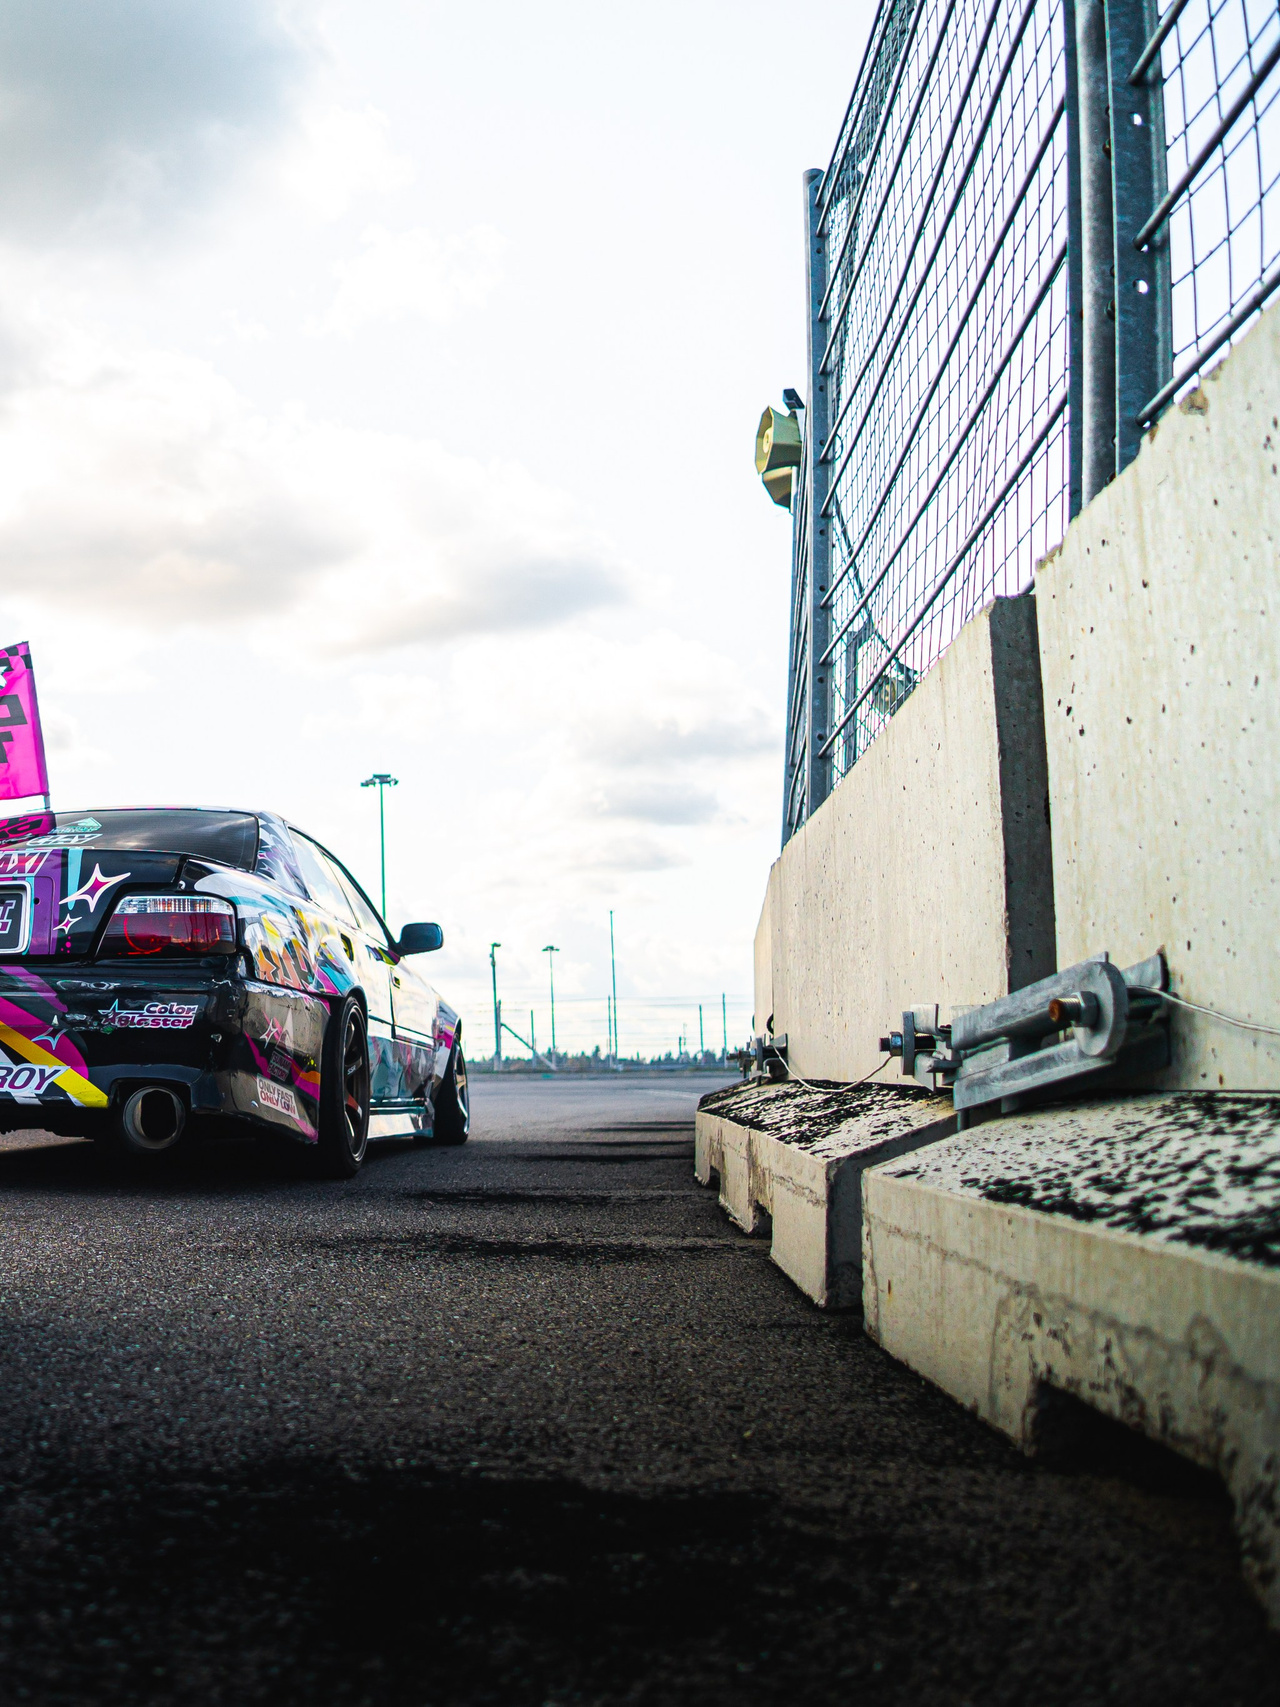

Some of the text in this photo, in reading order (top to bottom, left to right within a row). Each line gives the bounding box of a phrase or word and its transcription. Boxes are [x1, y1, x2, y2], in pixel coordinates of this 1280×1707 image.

[144, 1002, 198, 1016] Color
[118, 1014, 194, 1029] Blaster
[259, 1078, 294, 1107] ONLY FAST
[260, 1091, 279, 1107] ONLY
